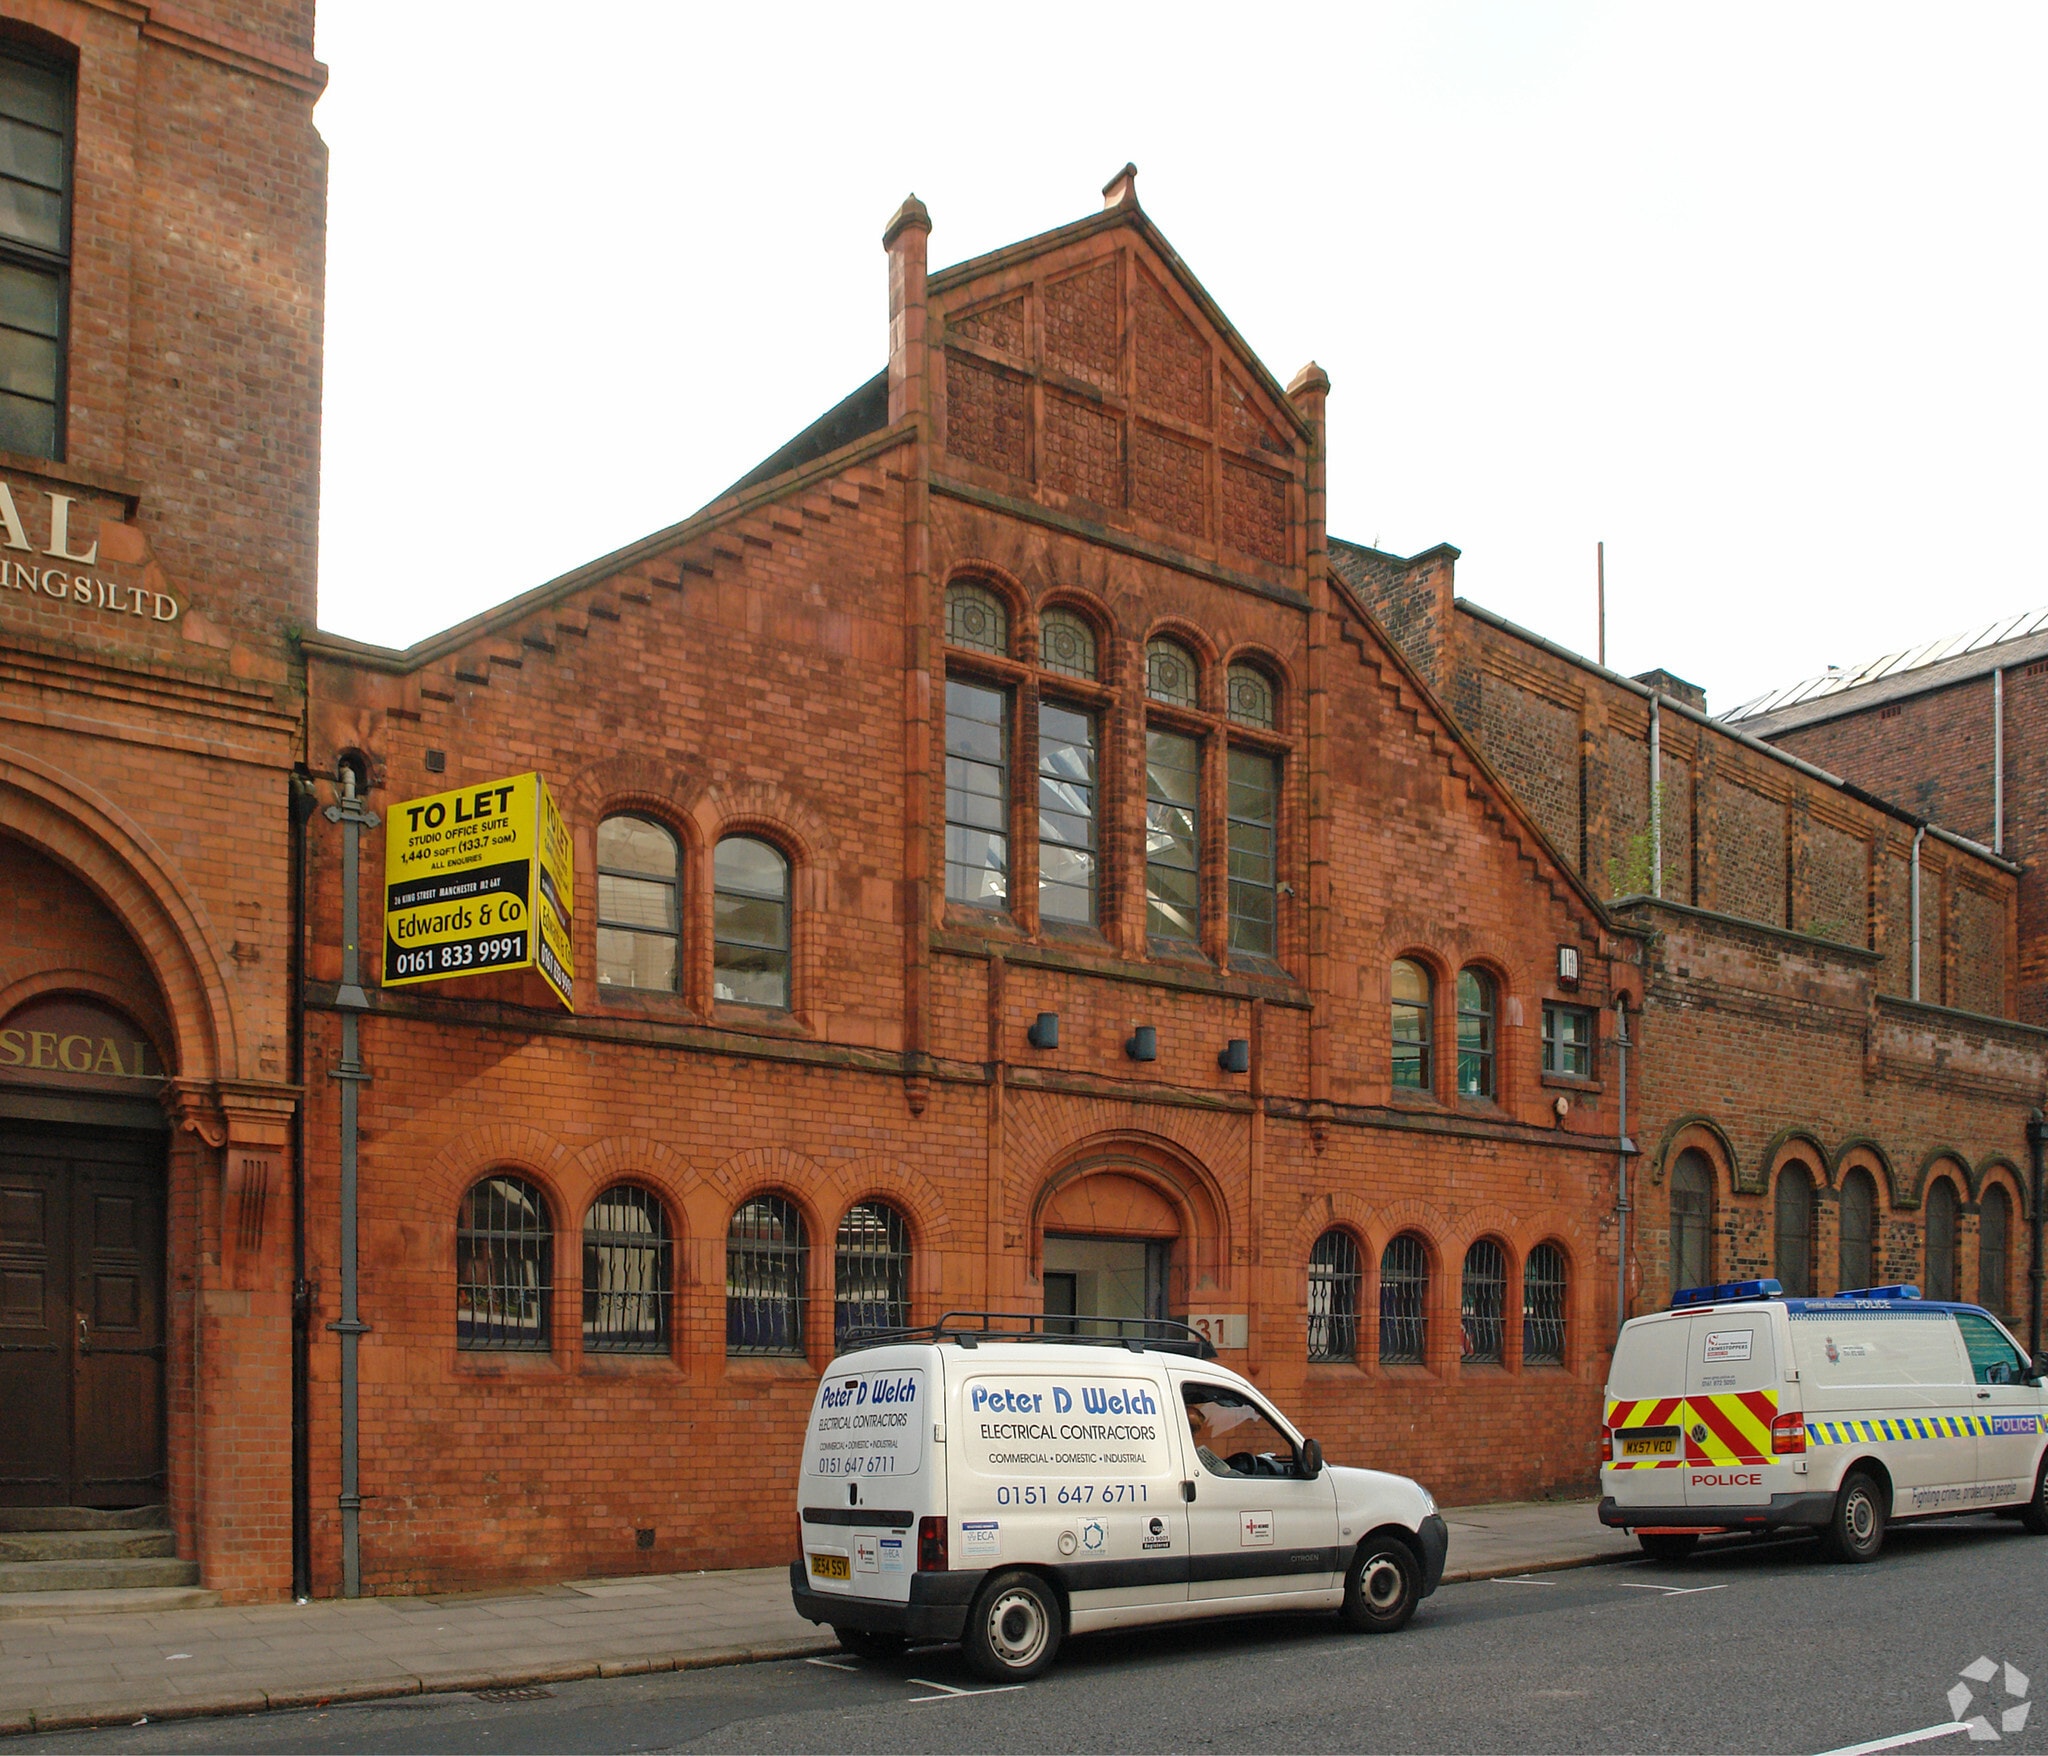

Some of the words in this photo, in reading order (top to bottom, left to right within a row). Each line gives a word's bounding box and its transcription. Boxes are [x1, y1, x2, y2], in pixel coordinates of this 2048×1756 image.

[406, 802, 446, 832] TO
[455, 785, 514, 823] LET
[408, 832, 441, 847] STUDIO
[445, 824, 478, 840] OFFICE
[481, 817, 509, 832] SUITE
[401, 848, 431, 864] 1,440
[458, 836, 489, 853] (133.7
[431, 862, 445, 870] ALL
[447, 854, 482, 867] ENQUIRIES
[402, 892, 415, 904] KING
[416, 889, 436, 901] STREET
[439, 882, 477, 897] MANCHESTER
[398, 906, 472, 939] Edwards
[479, 904, 492, 925] &
[499, 900, 521, 922] Co
[396, 950, 433, 974] 0161
[441, 944, 473, 967] 833
[479, 936, 521, 962] 9991
[1855, 1299, 1891, 1309] POLICE
[1195, 1318, 1224, 1345] 31
[821, 1386, 854, 1409] Peter
[856, 1381, 868, 1405] D
[871, 1377, 916, 1404] Welch
[971, 1384, 1042, 1413] Peter
[1052, 1386, 1073, 1414] D
[1082, 1387, 1157, 1415] Welch
[818, 1416, 851, 1431] ELECTRICAL
[853, 1413, 907, 1428] CONTRACTORS
[1994, 1418, 2035, 1432] POLICE
[980, 1424, 1057, 1440] ELECTRICAL
[1060, 1425, 1156, 1440] CONTRACTORS
[1626, 1441, 1651, 1454] MX57
[819, 1458, 841, 1473] 0151
[844, 1457, 864, 1473] 647
[867, 1456, 894, 1473] 6711
[988, 1453, 1049, 1464] COMMERCIAL
[1055, 1453, 1097, 1463] DOMESTIC
[1103, 1453, 1147, 1463] INDUSTRIAL
[1691, 1473, 1762, 1486] POLICE
[997, 1486, 1047, 1505] 0151
[1057, 1485, 1094, 1503] 647
[1102, 1484, 1147, 1503] 6711
[977, 1531, 994, 1541] ECA
[832, 1560, 847, 1576] SSV
